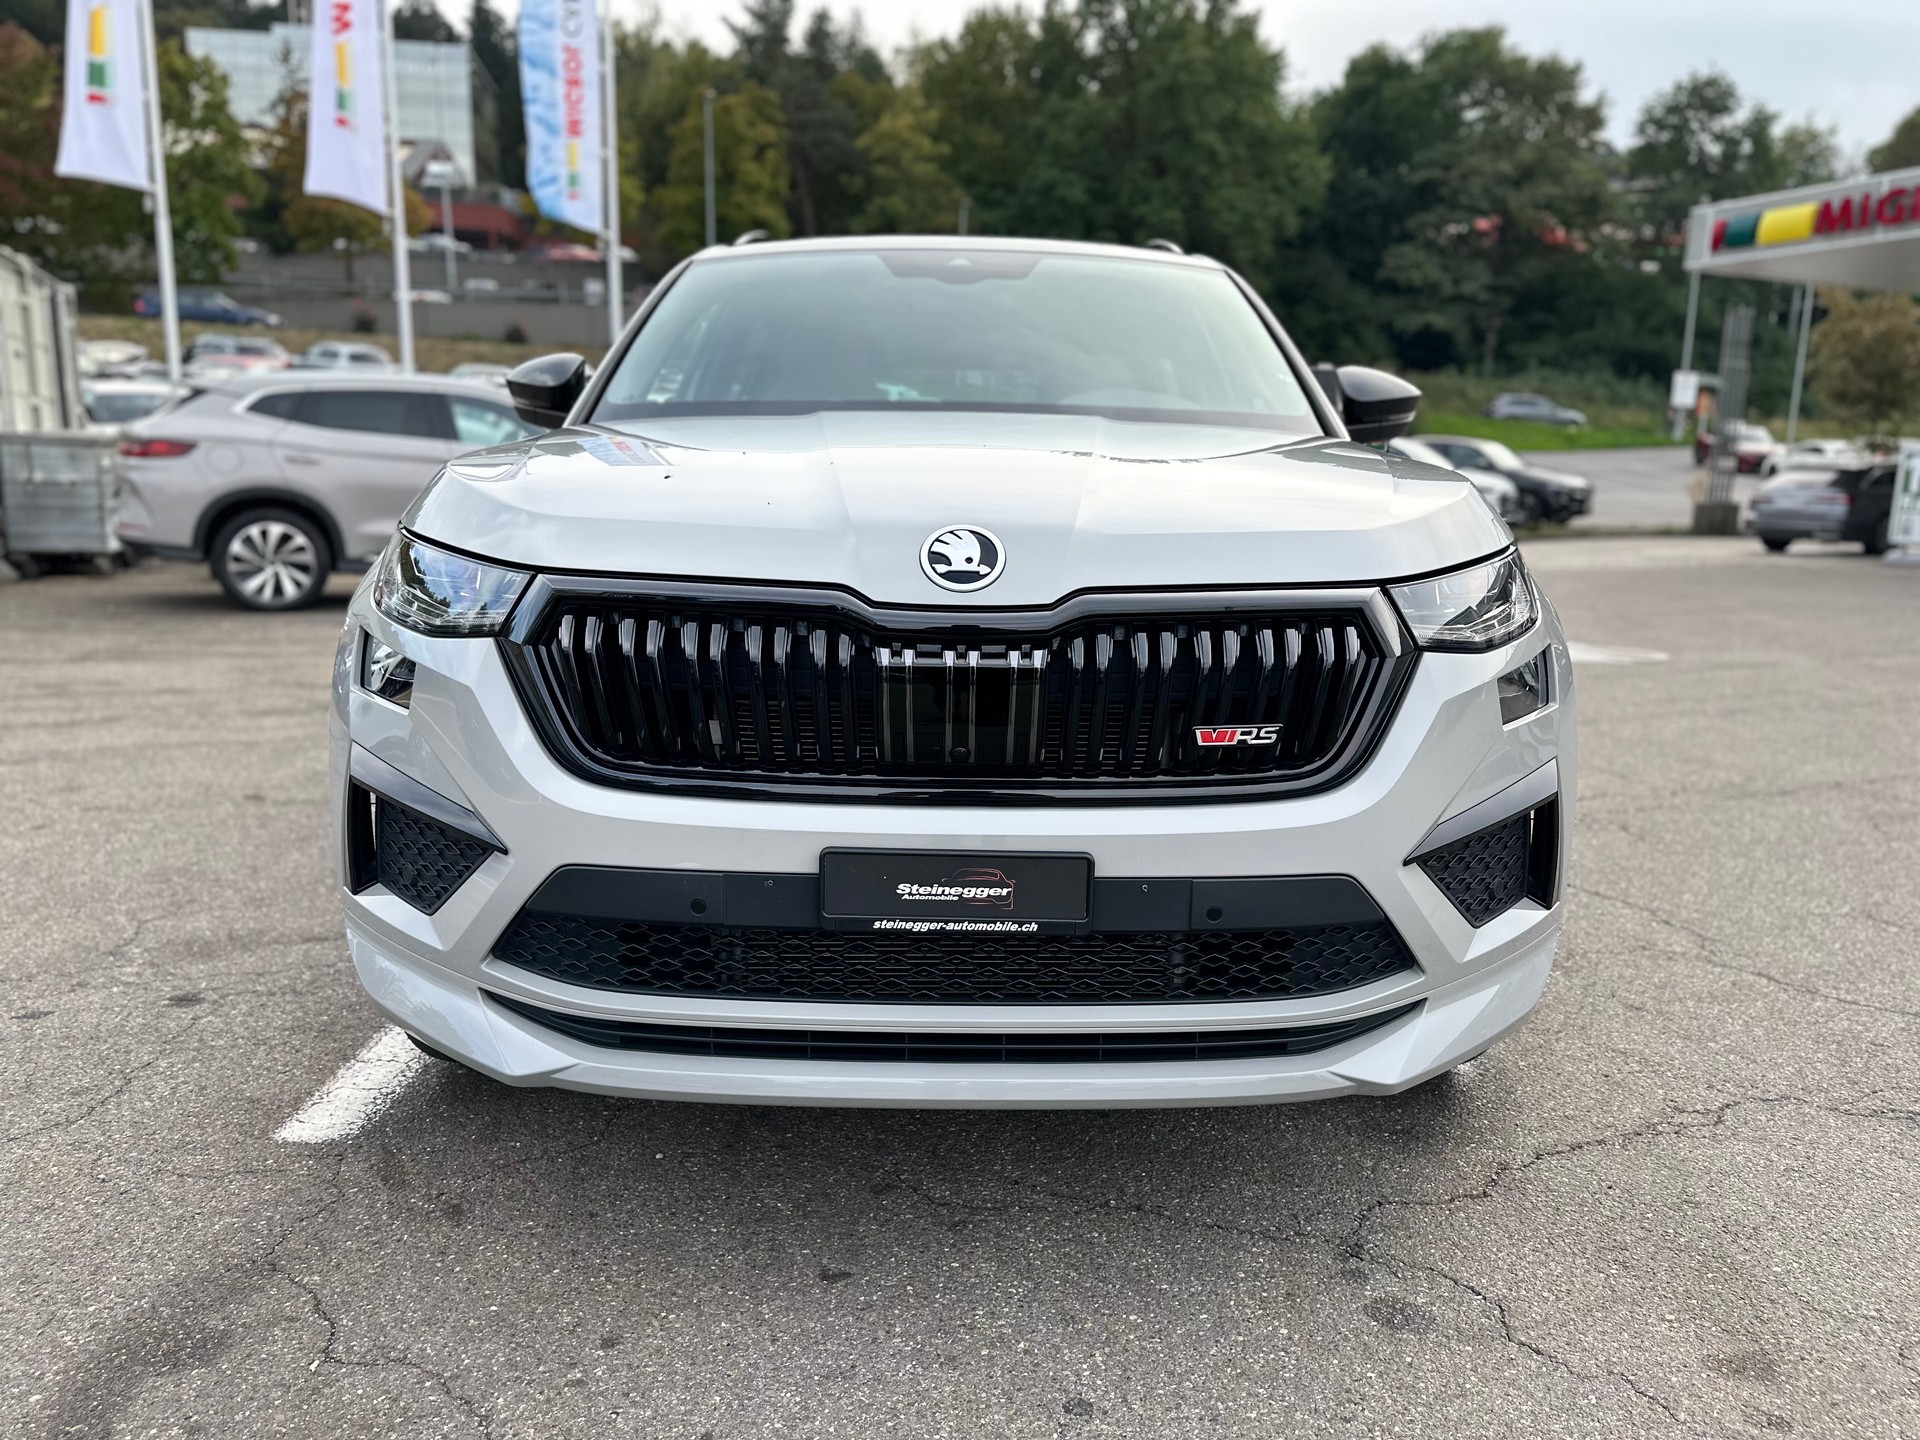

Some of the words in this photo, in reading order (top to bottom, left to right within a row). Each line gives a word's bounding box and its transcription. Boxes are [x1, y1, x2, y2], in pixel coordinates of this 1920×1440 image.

[896, 883, 1012, 898] Steinegger
[901, 893, 960, 901] Automobile
[873, 919, 1039, 932] steinegger-automobile.ch
